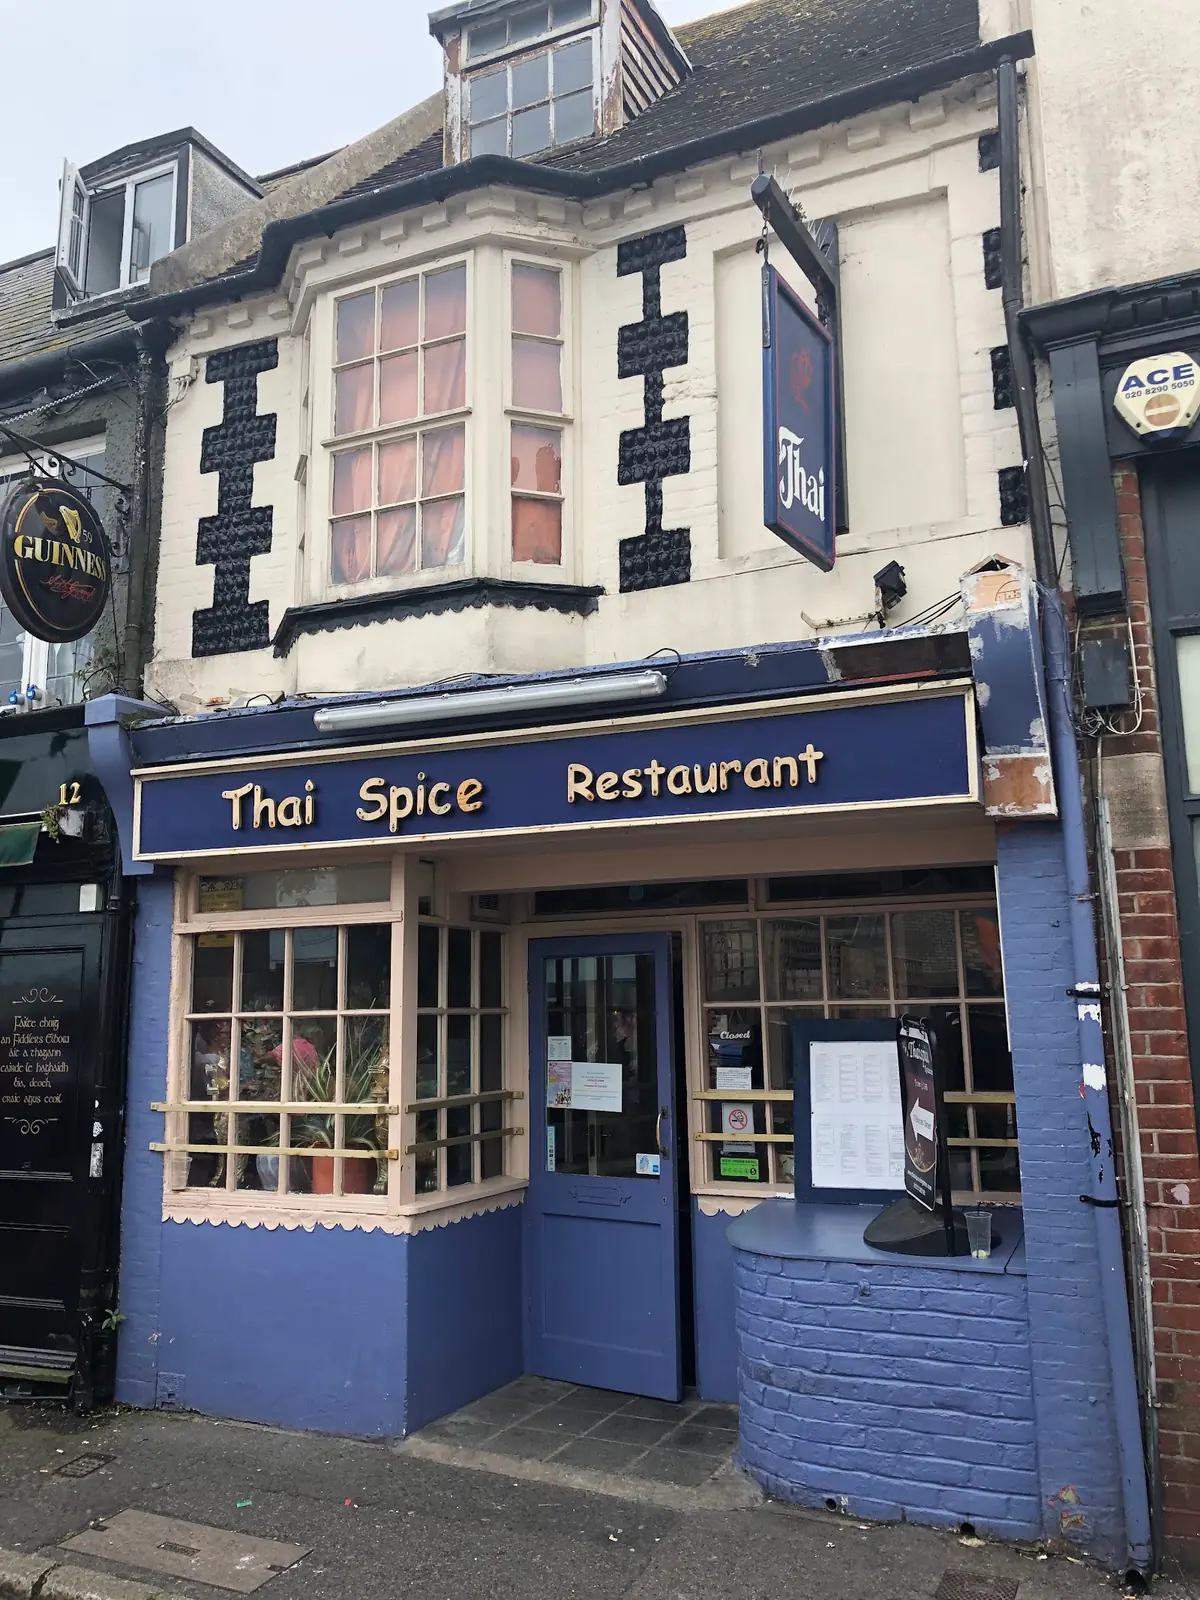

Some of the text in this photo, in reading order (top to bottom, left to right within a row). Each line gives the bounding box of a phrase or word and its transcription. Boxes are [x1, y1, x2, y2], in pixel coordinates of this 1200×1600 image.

[1122, 363, 1195, 392] ACE
[1125, 380, 1194, 399] 020 8290 5050
[779, 425, 825, 522] Thai
[14, 534, 107, 582] GUINNESS
[58, 782, 82, 806] 12
[221, 743, 824, 833] Thai Spice Restaurant
[45, 1033, 70, 1044] Elbow
[720, 1030, 751, 1040] Closed
